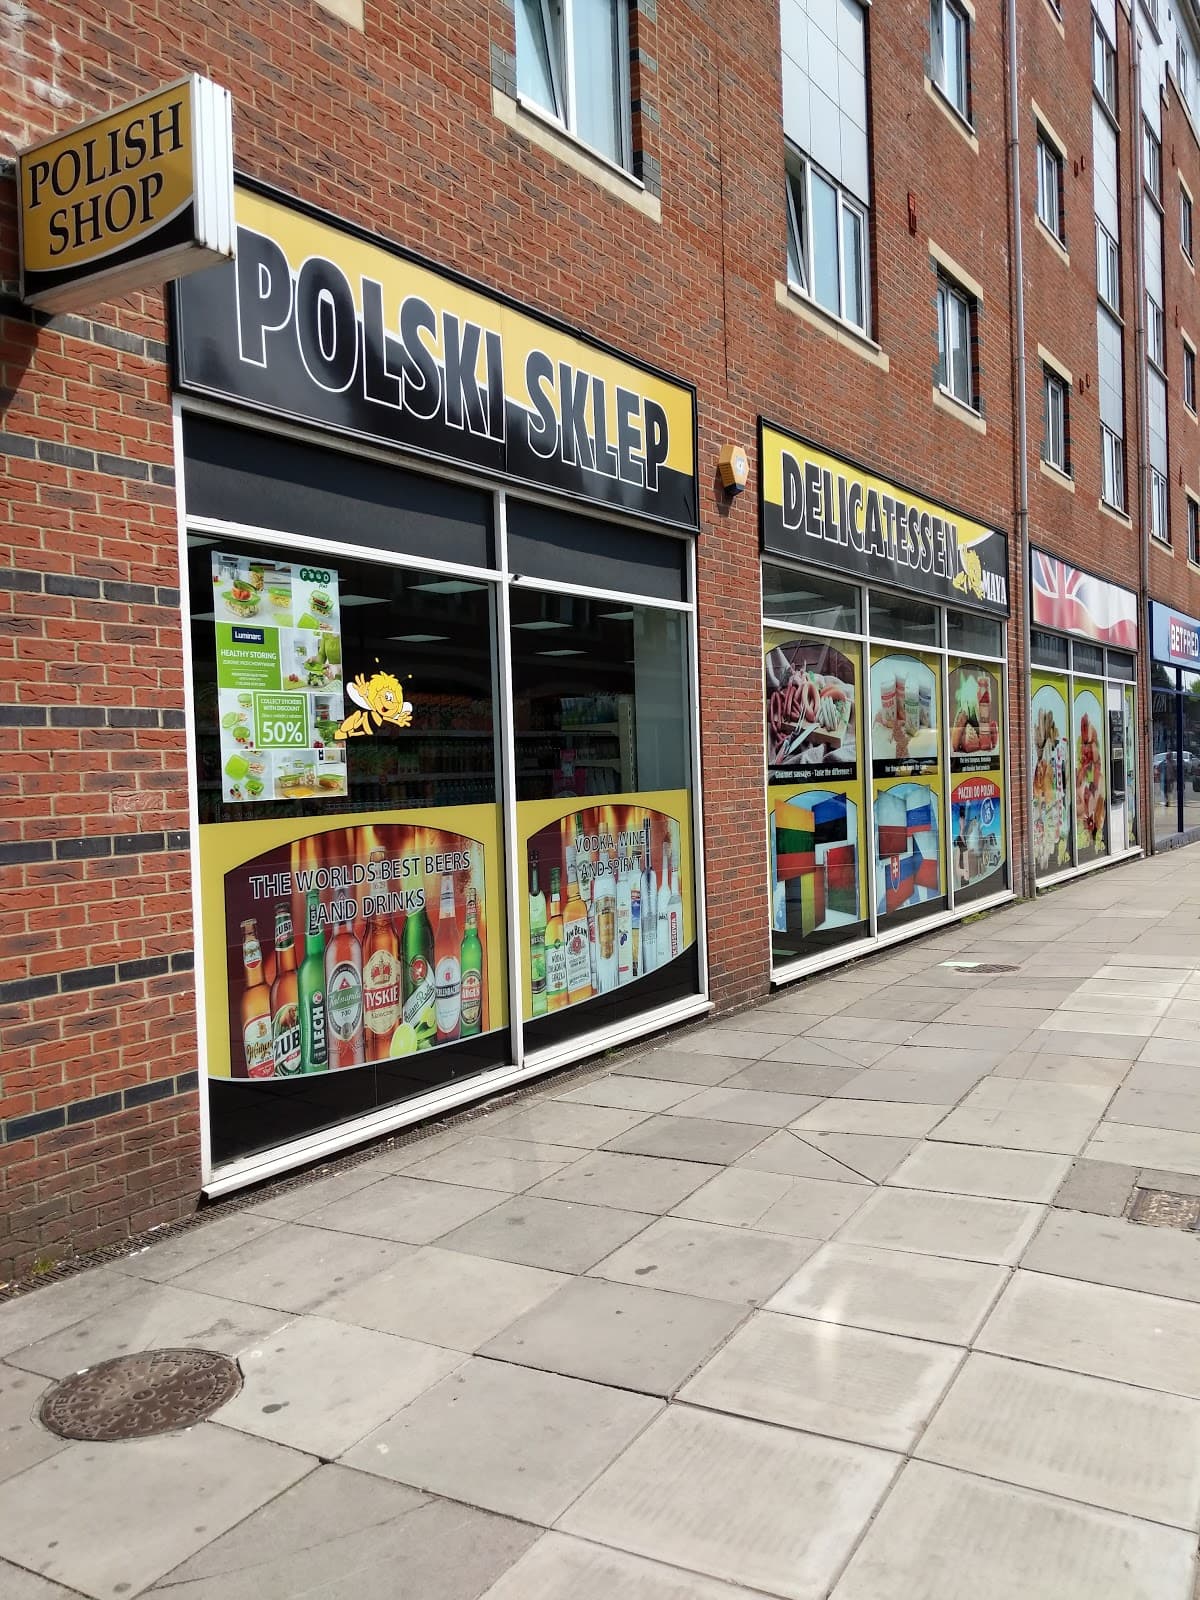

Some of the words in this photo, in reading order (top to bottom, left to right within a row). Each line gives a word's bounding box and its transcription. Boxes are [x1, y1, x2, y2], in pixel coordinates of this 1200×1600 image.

[28, 101, 184, 209] POLISH
[49, 172, 164, 256] SHOP
[235, 224, 506, 443] POLSKI
[525, 350, 670, 492] SKLEP
[781, 449, 961, 580] DELICATESSEN
[982, 569, 1008, 606] MAYA
[220, 648, 249, 659] HEALTHY
[249, 650, 277, 661] STORING
[1170, 623, 1199, 657] BETFRED
[262, 721, 304, 743] 50%
[973, 784, 981, 798] DO
[618, 829, 647, 847] WINE
[248, 871, 292, 900] THE
[295, 862, 377, 894] WORLDS
[380, 856, 421, 882] BEST
[424, 850, 471, 875] BEERS
[316, 898, 359, 926] AND
[361, 887, 426, 919] DRINKS
[364, 985, 399, 1009] TYSKIE
[312, 1005, 326, 1050] LECH
